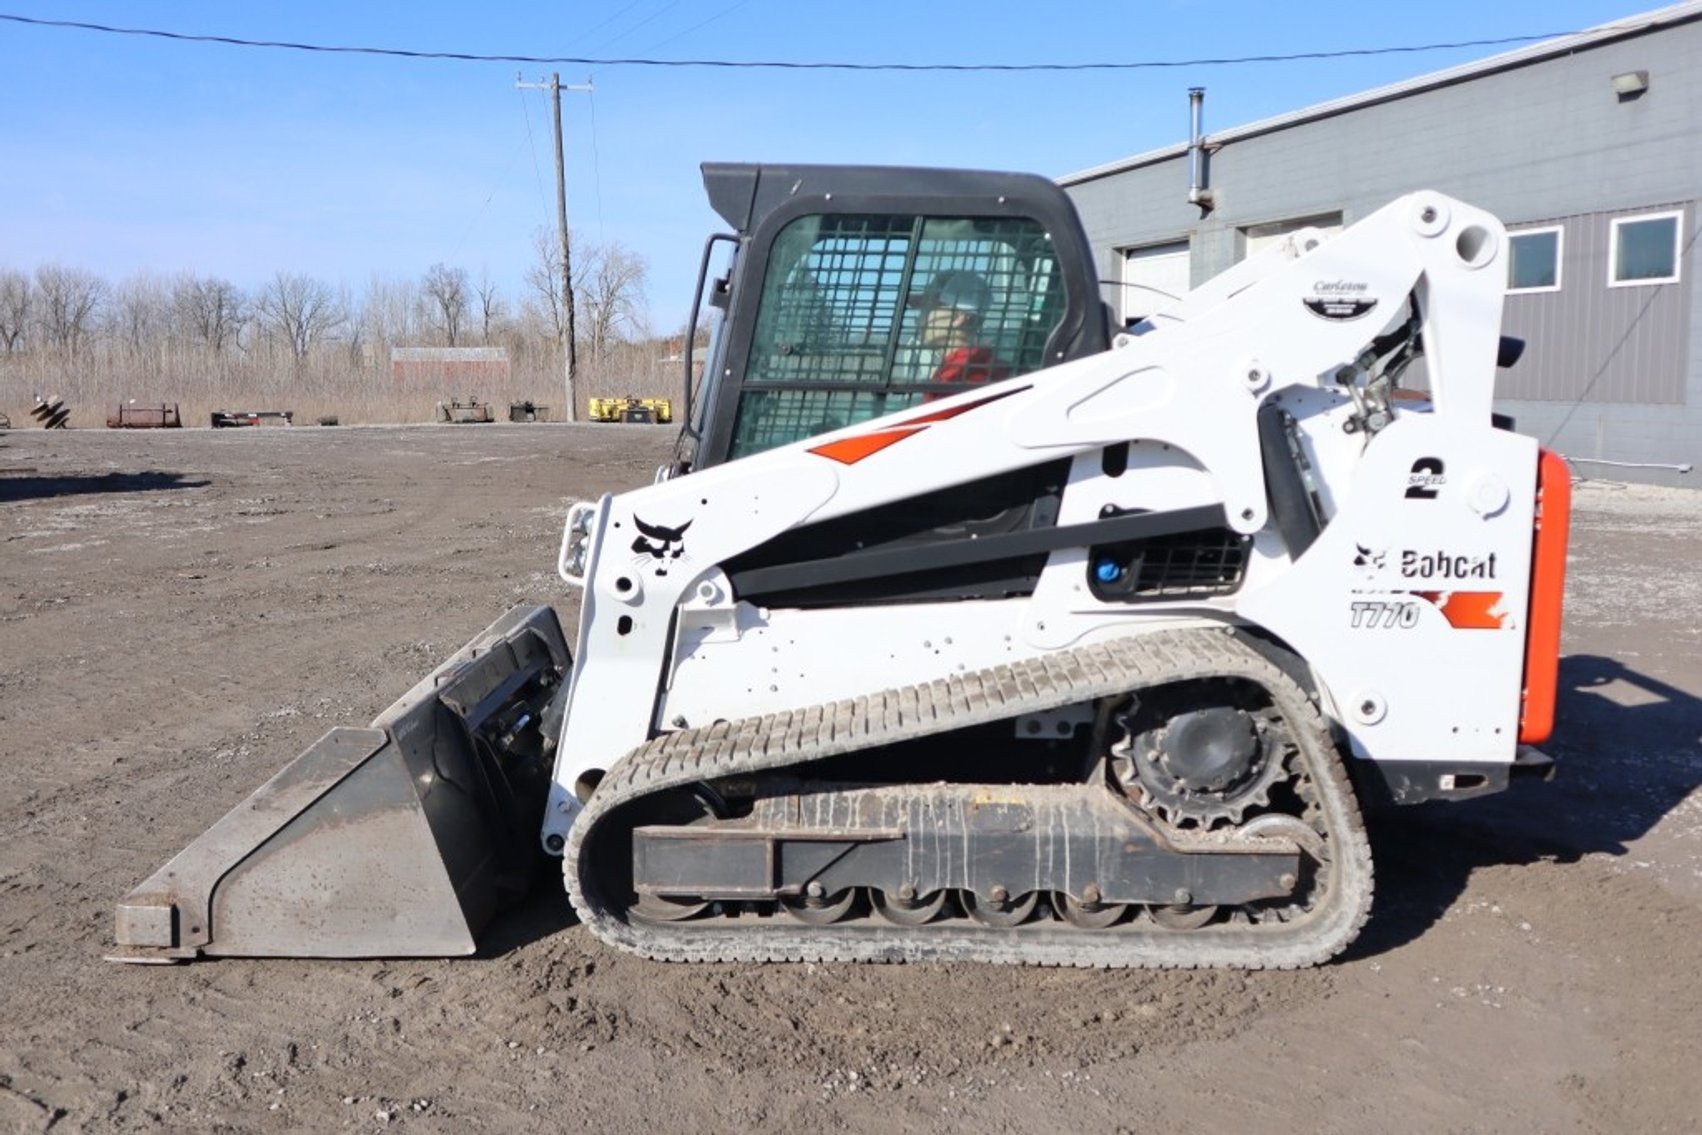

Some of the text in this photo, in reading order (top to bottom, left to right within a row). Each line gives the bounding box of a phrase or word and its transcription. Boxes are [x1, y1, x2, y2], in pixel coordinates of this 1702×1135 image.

[1404, 456, 1444, 499] 2
[1408, 475, 1447, 485] SPEED
[1402, 550, 1496, 579] Bobcat
[1350, 601, 1420, 629] T770
